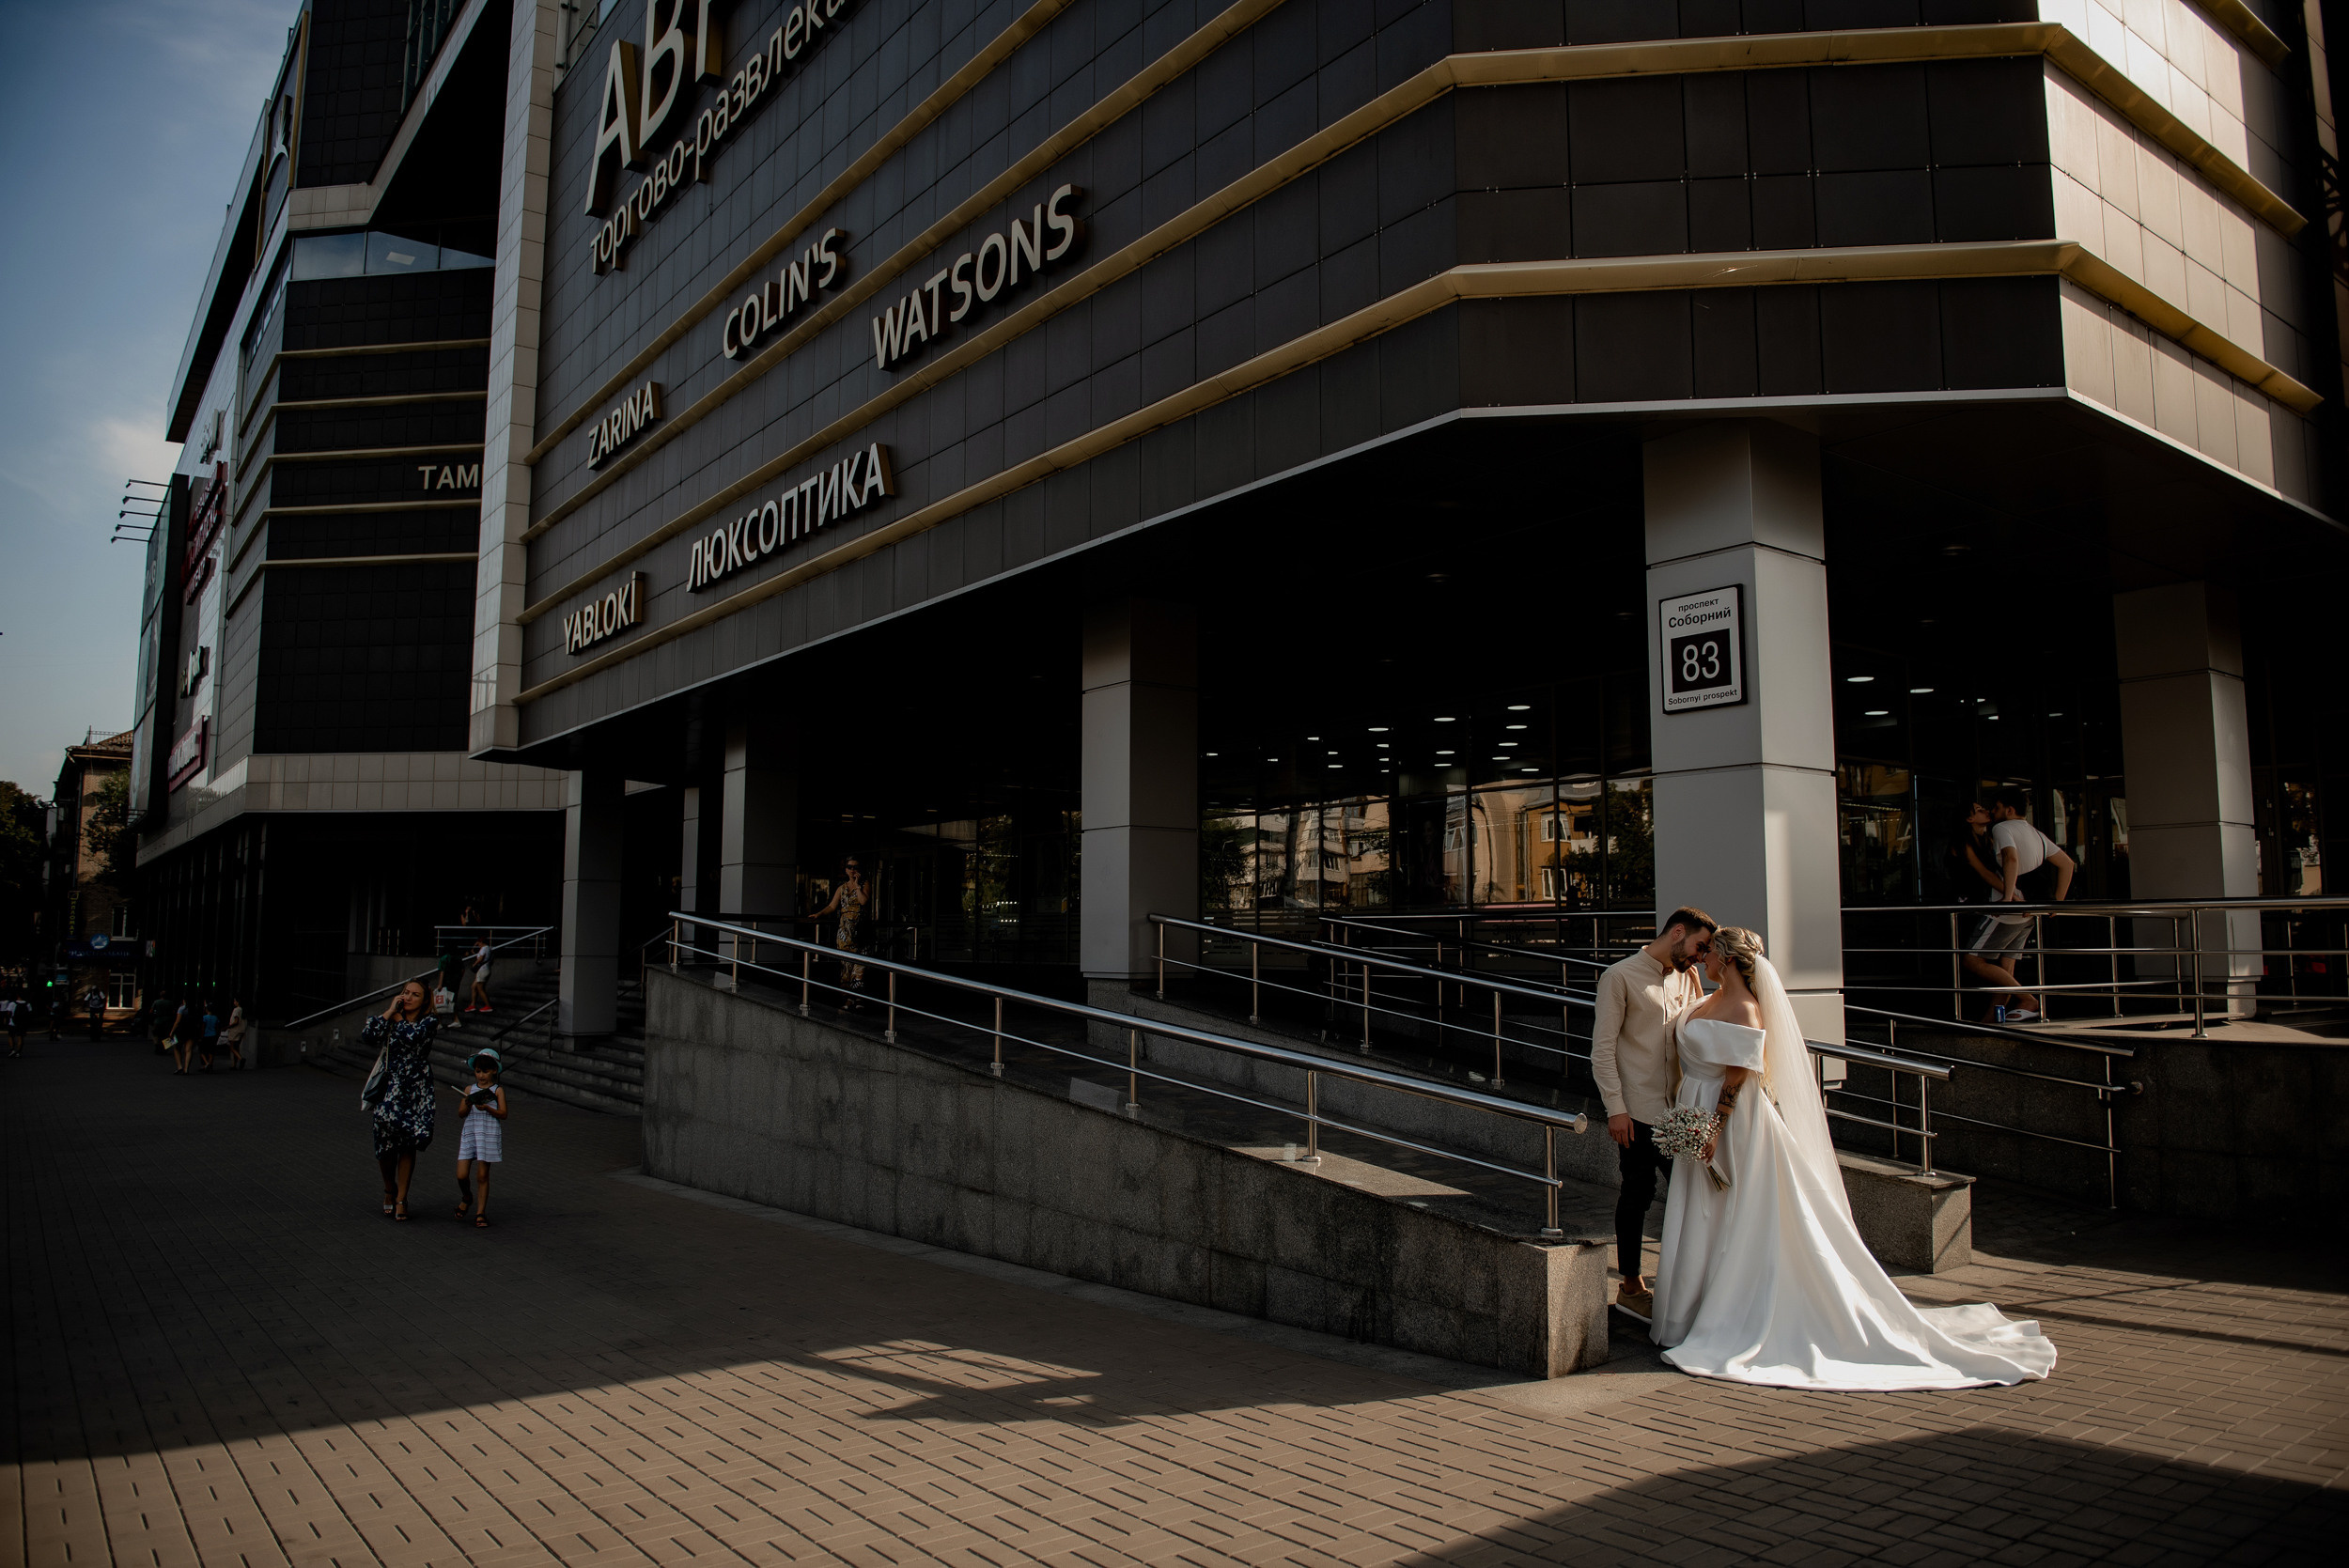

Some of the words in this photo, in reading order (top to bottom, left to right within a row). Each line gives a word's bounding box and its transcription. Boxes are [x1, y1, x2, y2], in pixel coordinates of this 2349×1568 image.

[723, 228, 842, 359] COLIN'S
[873, 183, 1077, 369] WATSONS
[587, 381, 656, 469] ZARINA
[686, 442, 887, 592] ЛЮКСОПТИКА
[1669, 606, 1731, 629] Соборний
[1678, 598, 1719, 613] проспект
[1682, 641, 1720, 682] 83
[1668, 693, 1701, 705] Sobornyi
[1703, 689, 1737, 702] prospekt
